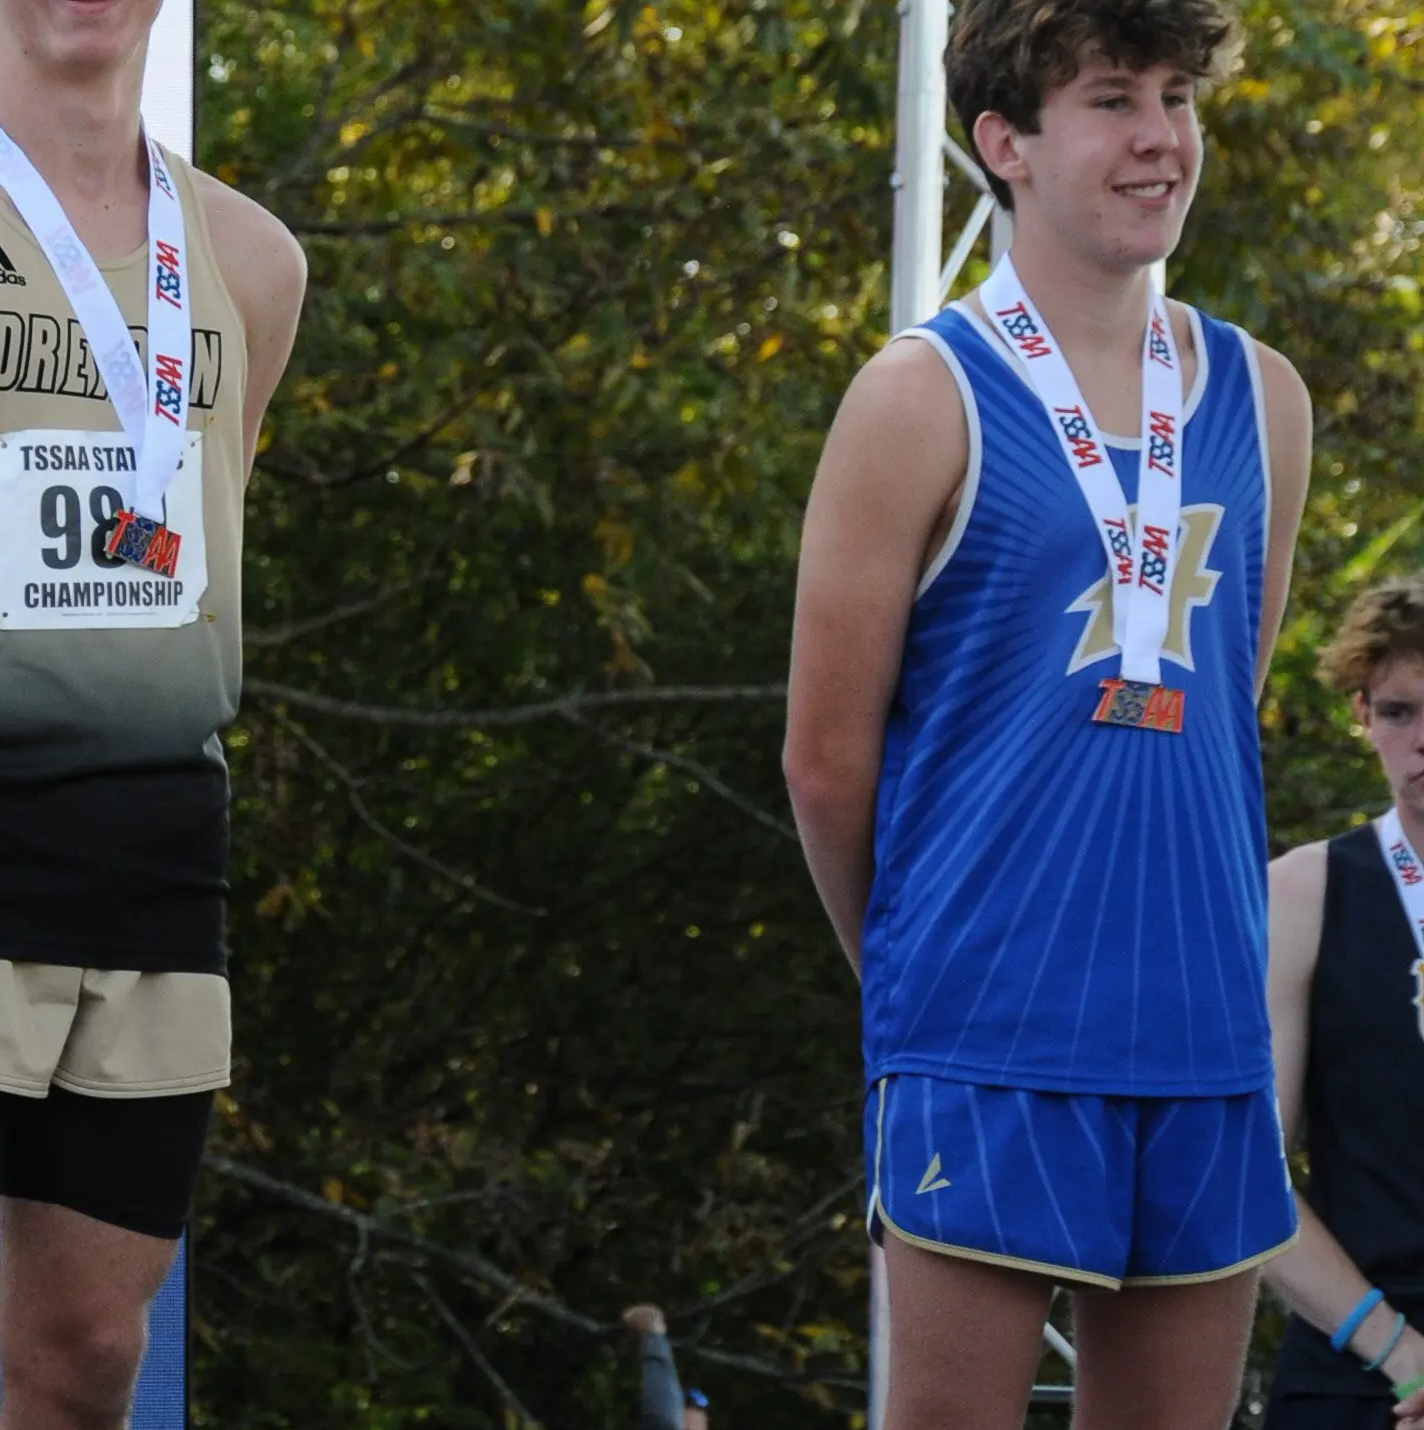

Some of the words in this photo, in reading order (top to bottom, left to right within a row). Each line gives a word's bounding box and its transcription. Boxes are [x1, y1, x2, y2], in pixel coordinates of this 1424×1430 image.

[155, 239, 182, 310] TSSAA
[996, 301, 1052, 359] TSSAA
[154, 353, 183, 427] TSSAA
[20, 445, 91, 472] TSSAA
[93, 446, 138, 472] STAT
[1054, 405, 1103, 468] TSSAA
[1148, 410, 1176, 477] TSSAA
[40, 485, 167, 569] 98
[1138, 525, 1170, 596] TSSAA
[24, 581, 184, 608] CHAMPIONSHIP
